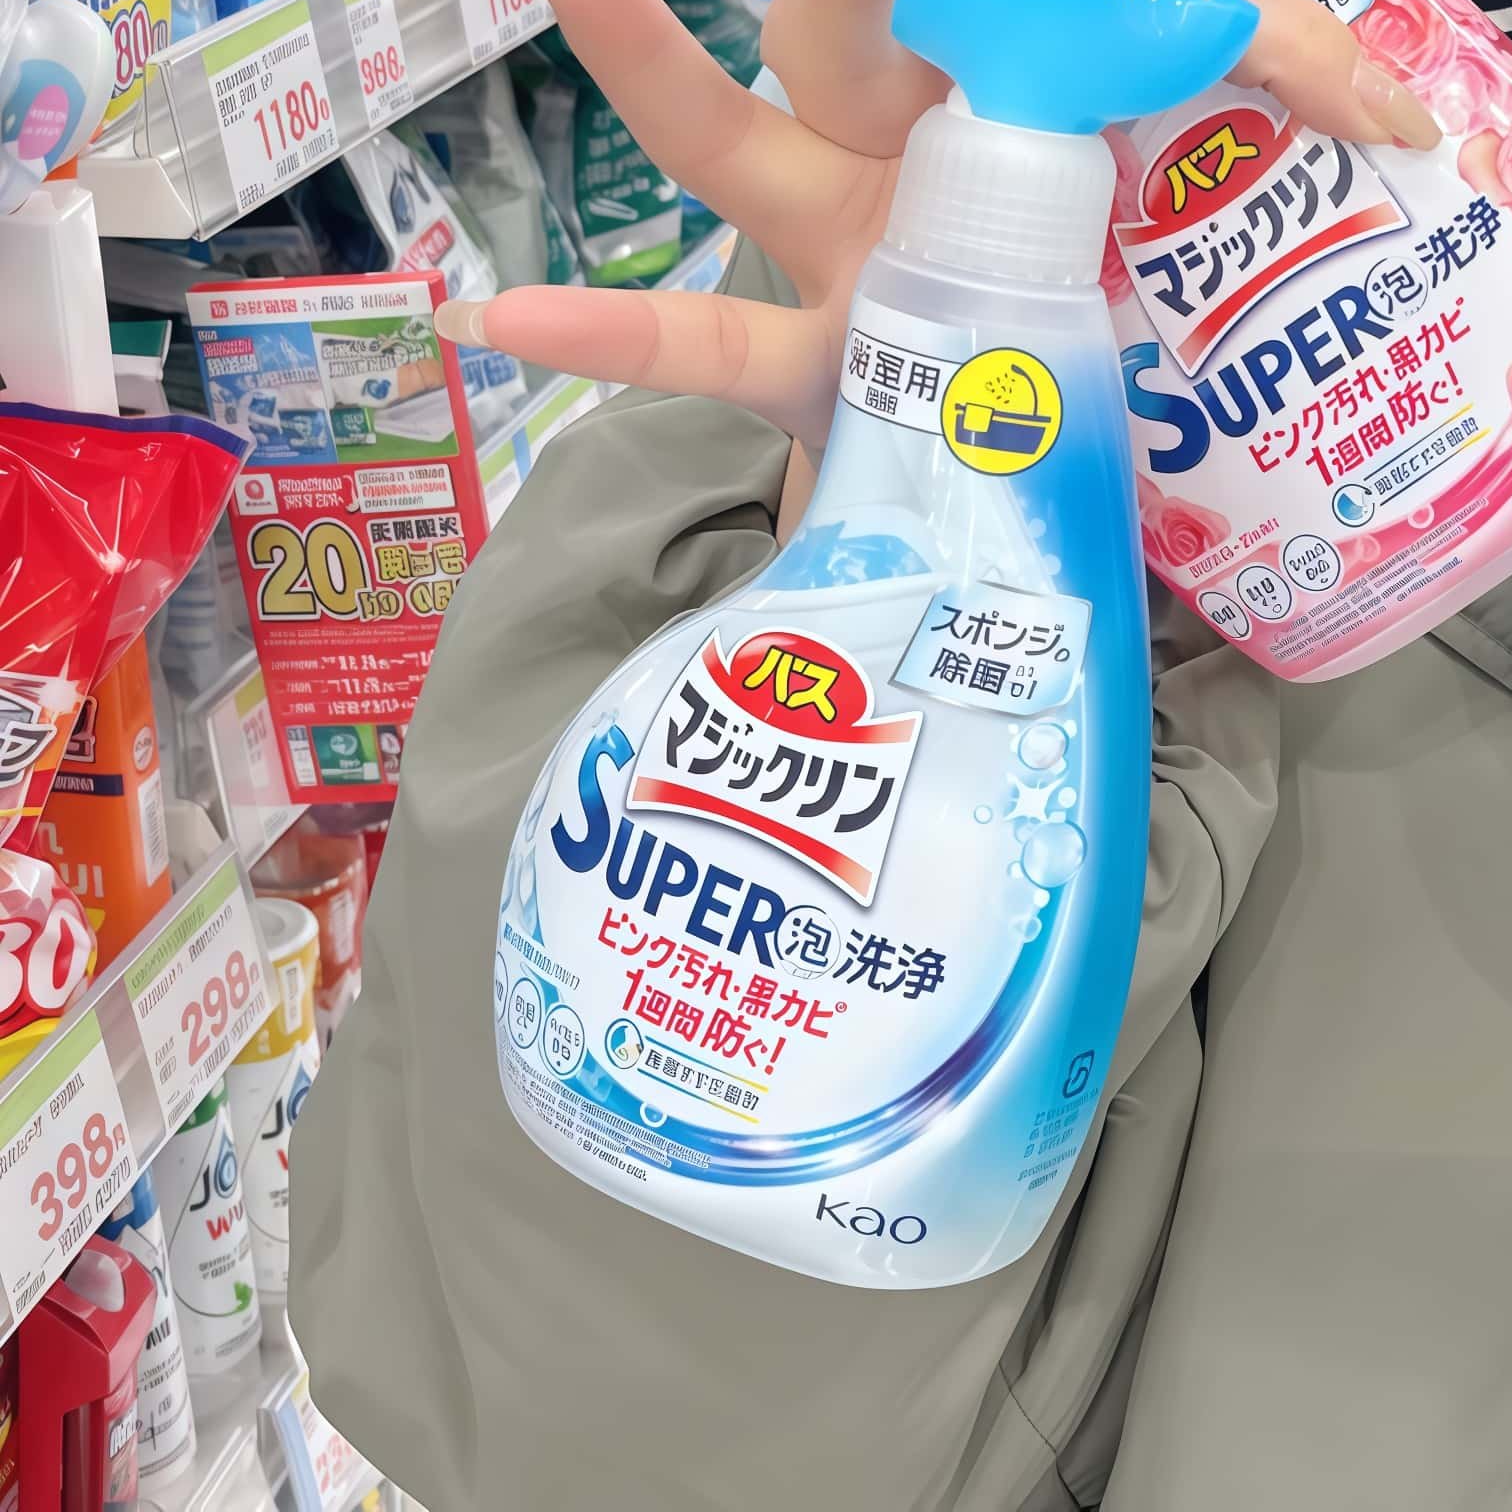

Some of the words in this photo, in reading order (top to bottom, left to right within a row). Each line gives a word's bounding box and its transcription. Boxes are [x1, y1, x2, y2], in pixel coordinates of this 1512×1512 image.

[1134, 135, 1355, 319] マジックリン
[1163, 122, 1261, 214] バス
[1120, 284, 1393, 475] SUPER
[665, 679, 896, 834] マジックリン
[742, 644, 840, 724] バス
[550, 723, 787, 969] SUPER
